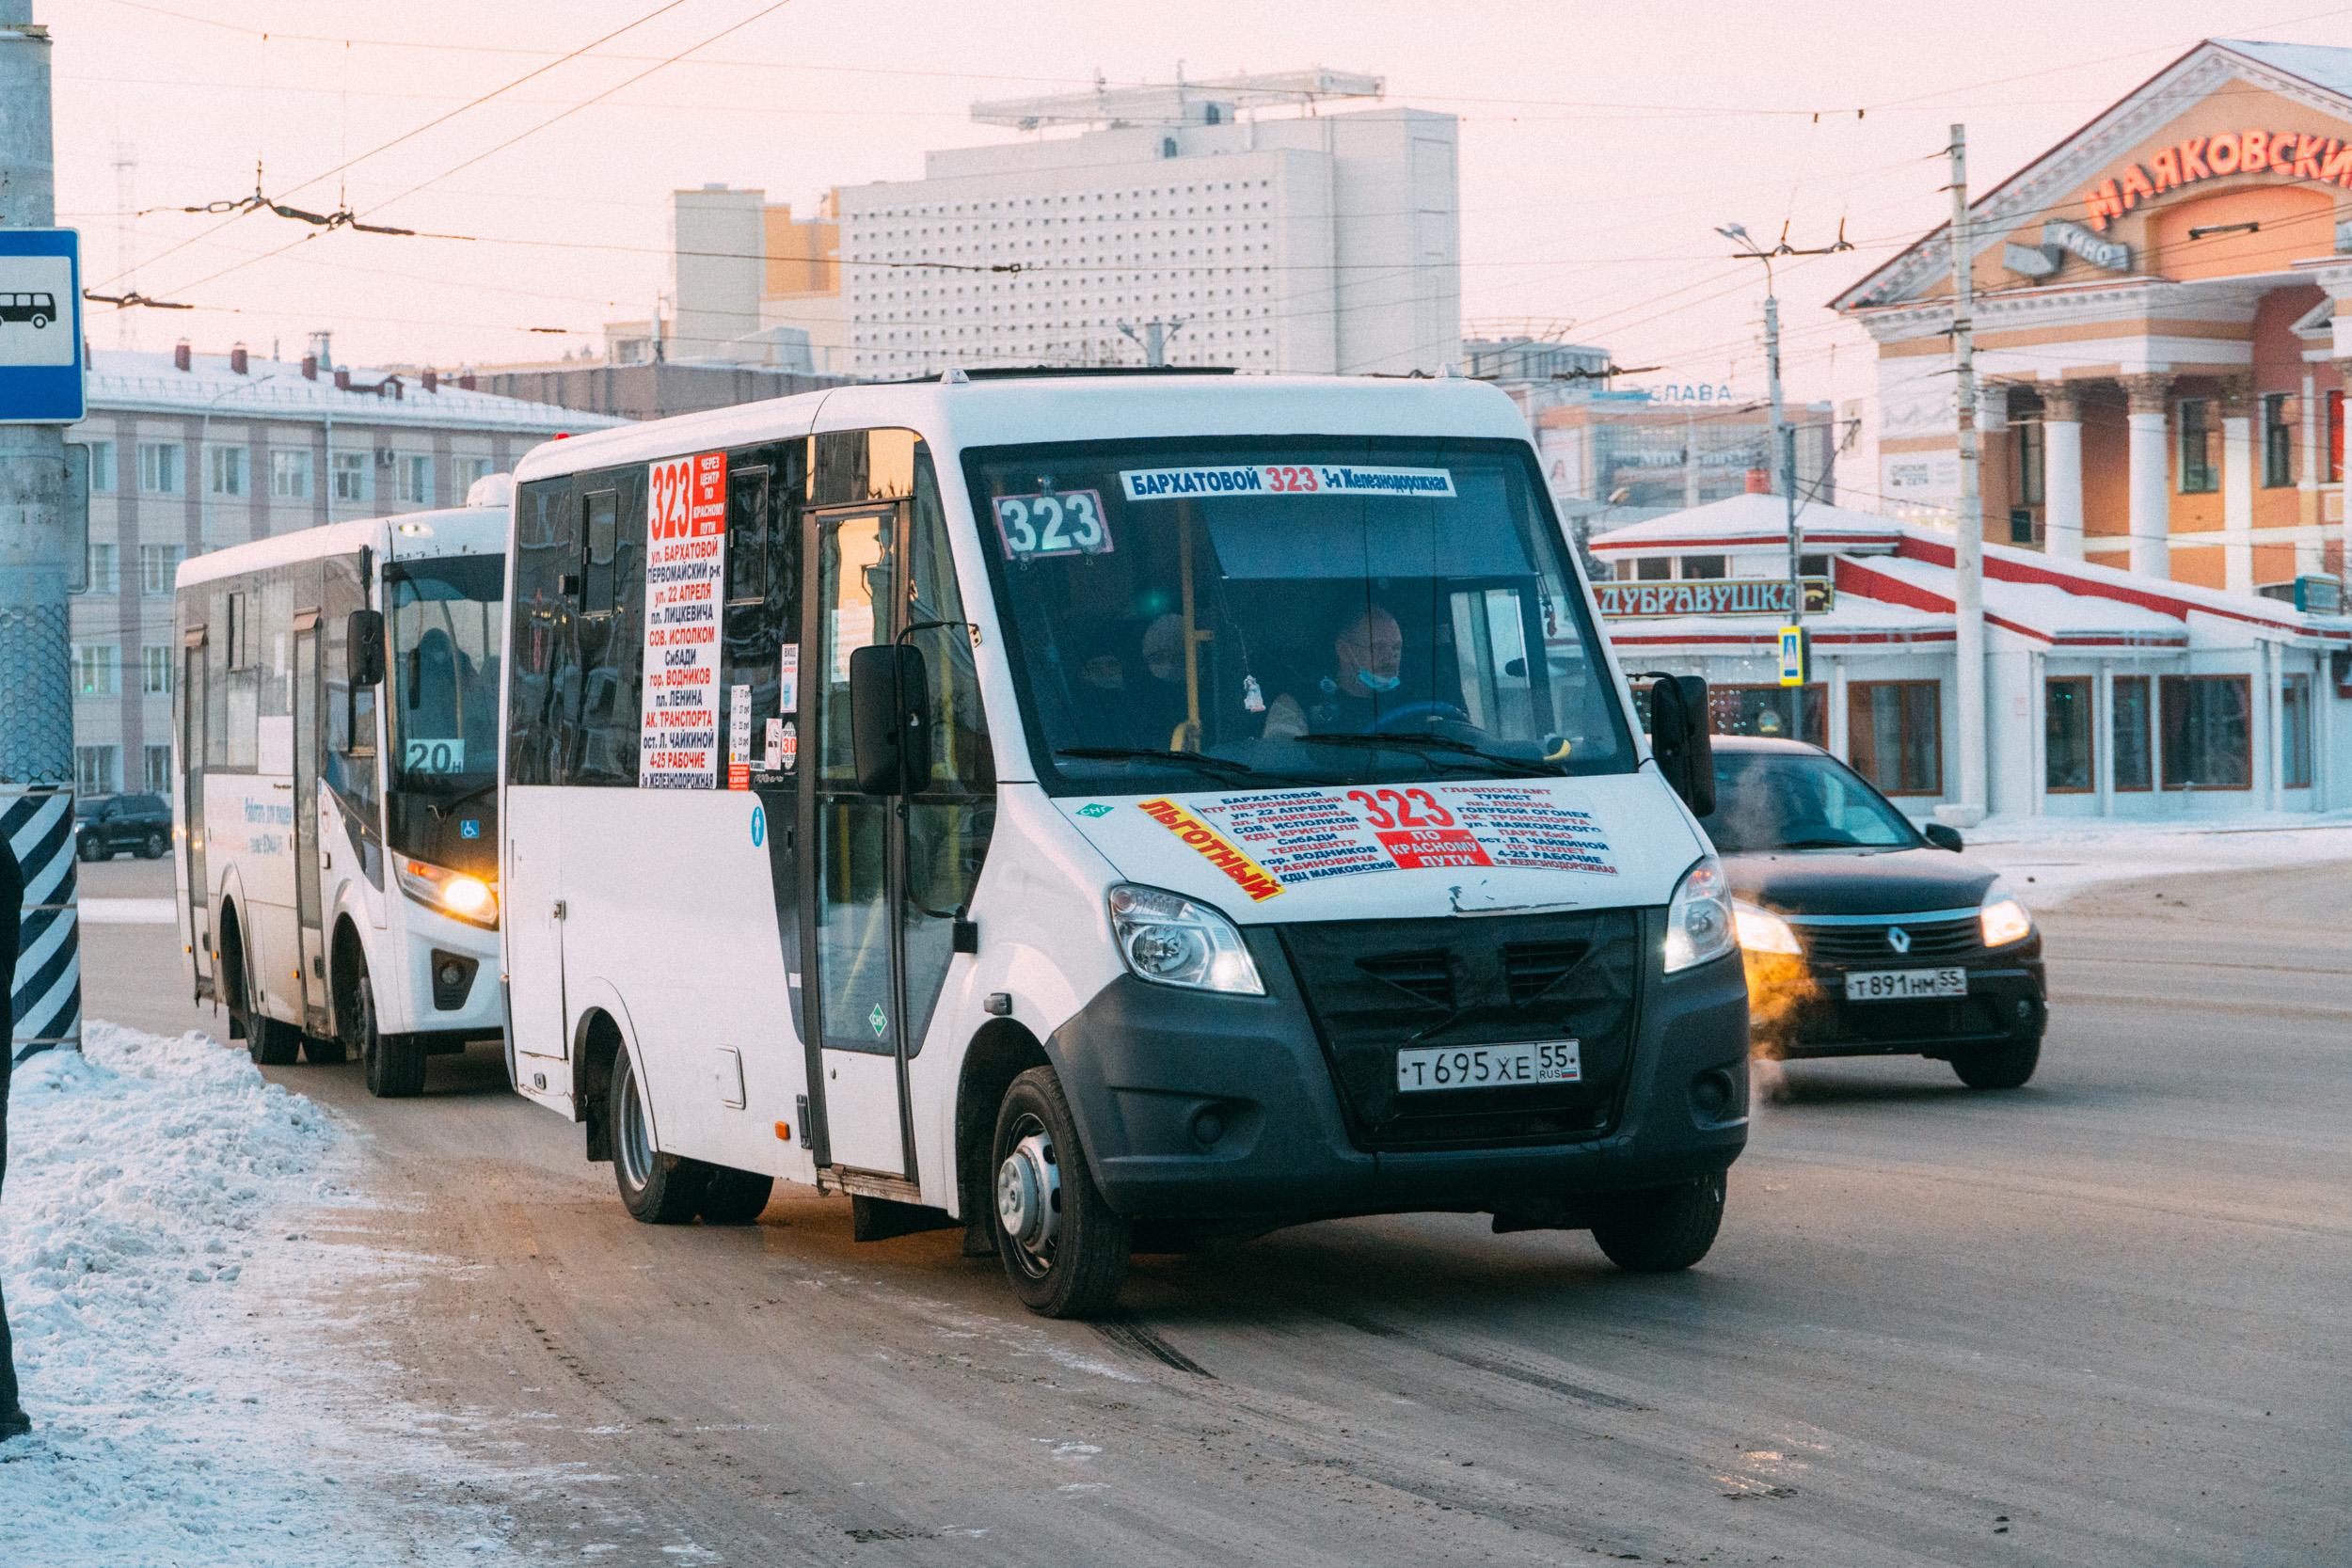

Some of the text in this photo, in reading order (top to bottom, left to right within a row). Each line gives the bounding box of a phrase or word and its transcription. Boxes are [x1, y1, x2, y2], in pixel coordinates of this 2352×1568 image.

[2083, 129, 2352, 232] МАЯКОВСКИ
[2058, 225, 2112, 266] КИНО
[701, 456, 720, 470] ЧЕРЕЗ
[700, 471, 720, 487] ЦЕНТР
[1131, 465, 1262, 495] БАРХАТОВОЙ
[1264, 467, 1319, 493] 323
[1341, 468, 1449, 494] Железнодорожная
[705, 487, 714, 499] ПО
[651, 461, 691, 542] 323
[692, 502, 724, 518] КРАСНОМУ
[700, 521, 716, 535] ПУТИ
[1000, 494, 1103, 552] 323
[651, 537, 718, 566] ул. БАРХАТОВОЙ
[647, 559, 721, 584] ПЕРВОМАЙСКИЙ р-к
[655, 582, 711, 608] ул. 22 АПРЕЛЯ
[651, 604, 713, 626] пл. ЛИЦКЕВИЧА
[649, 626, 715, 647] СОВ. ИСПОЛКОМ
[665, 648, 696, 668] СибАДИ
[650, 668, 710, 690] гор. ВОДНИКОВ
[656, 689, 703, 707] пл. ЛЕНИНА
[645, 709, 712, 727] АК. ТРАНСПОРТА
[644, 736, 658, 749] ост.
[669, 728, 714, 749] ЧАЙКИНОЙ
[783, 737, 797, 753] 30
[650, 752, 706, 768] 4-25 РАБОЧИЕ
[649, 773, 714, 788] ЖЕЛЕЗНОДОРОЖНАЯ
[1221, 790, 1323, 804] БАРХАТОВОЙ
[1440, 786, 1551, 795] ГЛАВПОЧТАМТ
[1079, 806, 1106, 816] СНГ
[1230, 796, 1344, 811] ПЕРВОМАЙСКИЙ
[1231, 803, 1339, 820] ул. 22 АПРЕЛЯ
[1346, 788, 1455, 830] 323
[1493, 800, 1554, 809] ЛЕНИНА
[1257, 809, 1351, 824] ЛИЦКЕВИЧА
[1456, 806, 1592, 818] ГОЛУБОЙ ОГОНЕК
[1233, 815, 1359, 834] СОВ. ИСПОЛКОМ
[1465, 820, 1602, 833] ул. МАЯКОВСКОГО
[1490, 815, 1591, 826] ТРАНСПОРТА
[1243, 823, 1361, 842] КДЦ КРИСТАЛЛ
[1277, 832, 1338, 846] СибАДИ
[1411, 831, 1441, 840] ПО
[1498, 829, 1573, 839] ПАРК КиО
[1137, 800, 1281, 900] ЛЬГОТНЫЙ
[1267, 839, 1357, 855] ТЕЛЕЦЕНТР
[1388, 841, 1478, 856] КРАСНОМУ
[1526, 837, 1611, 850] ЧАЙКИНОЙ
[1534, 845, 1586, 855] ПОЛЕТ
[1260, 846, 1378, 866] гор. ВОДНИКОВ
[1271, 853, 1379, 874] РАБИНОВИЧА
[1418, 854, 1475, 867] ПУТИ
[1498, 849, 1604, 864] 4-25 РАБОЧИЕ
[1279, 860, 1398, 883] КДЦ МАЯКОВСКИЙ
[1507, 858, 1619, 875] ЖЕЛЕЗНОДОРОЖНАЯ
[1939, 971, 1959, 987] 55
[1539, 1044, 1569, 1069] 55
[1539, 1069, 1562, 1080] RUS
